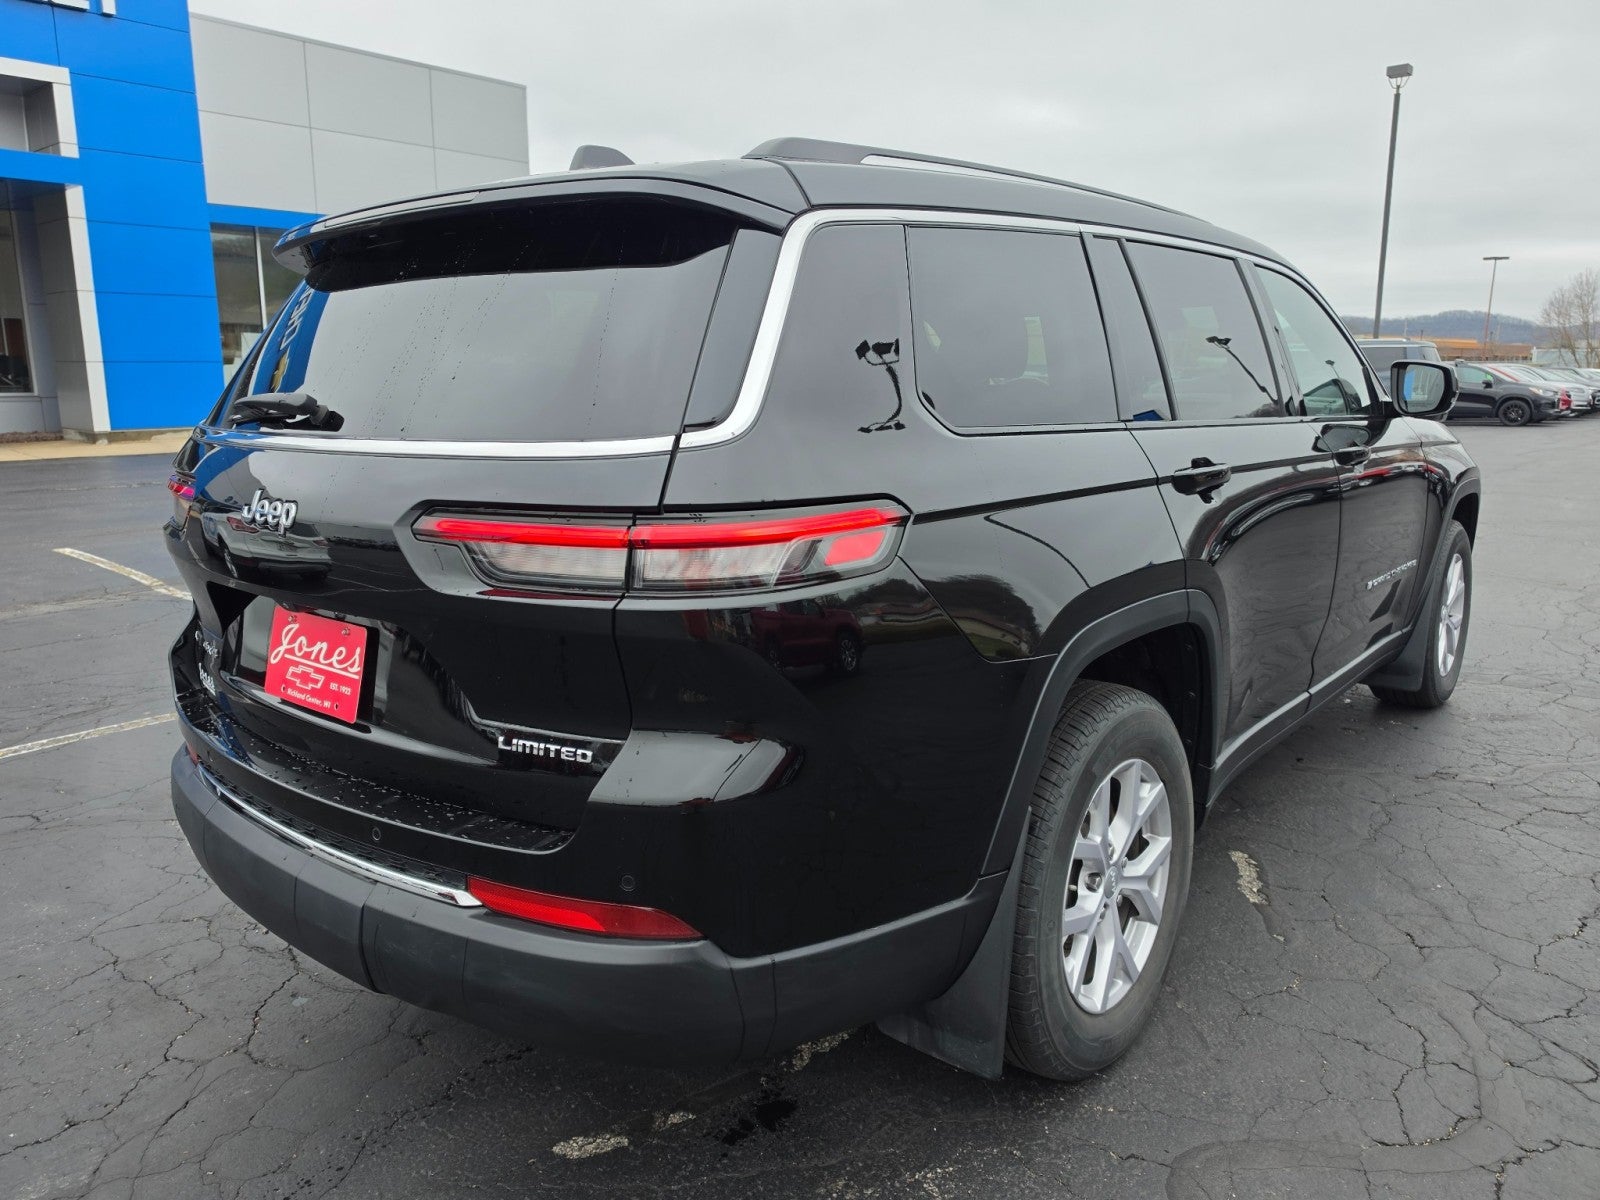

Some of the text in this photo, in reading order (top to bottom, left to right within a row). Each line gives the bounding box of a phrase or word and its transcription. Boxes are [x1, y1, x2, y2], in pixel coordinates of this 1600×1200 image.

[241, 489, 297, 535] Jeep
[270, 623, 361, 673] Jones
[497, 736, 593, 764] LIMITED
